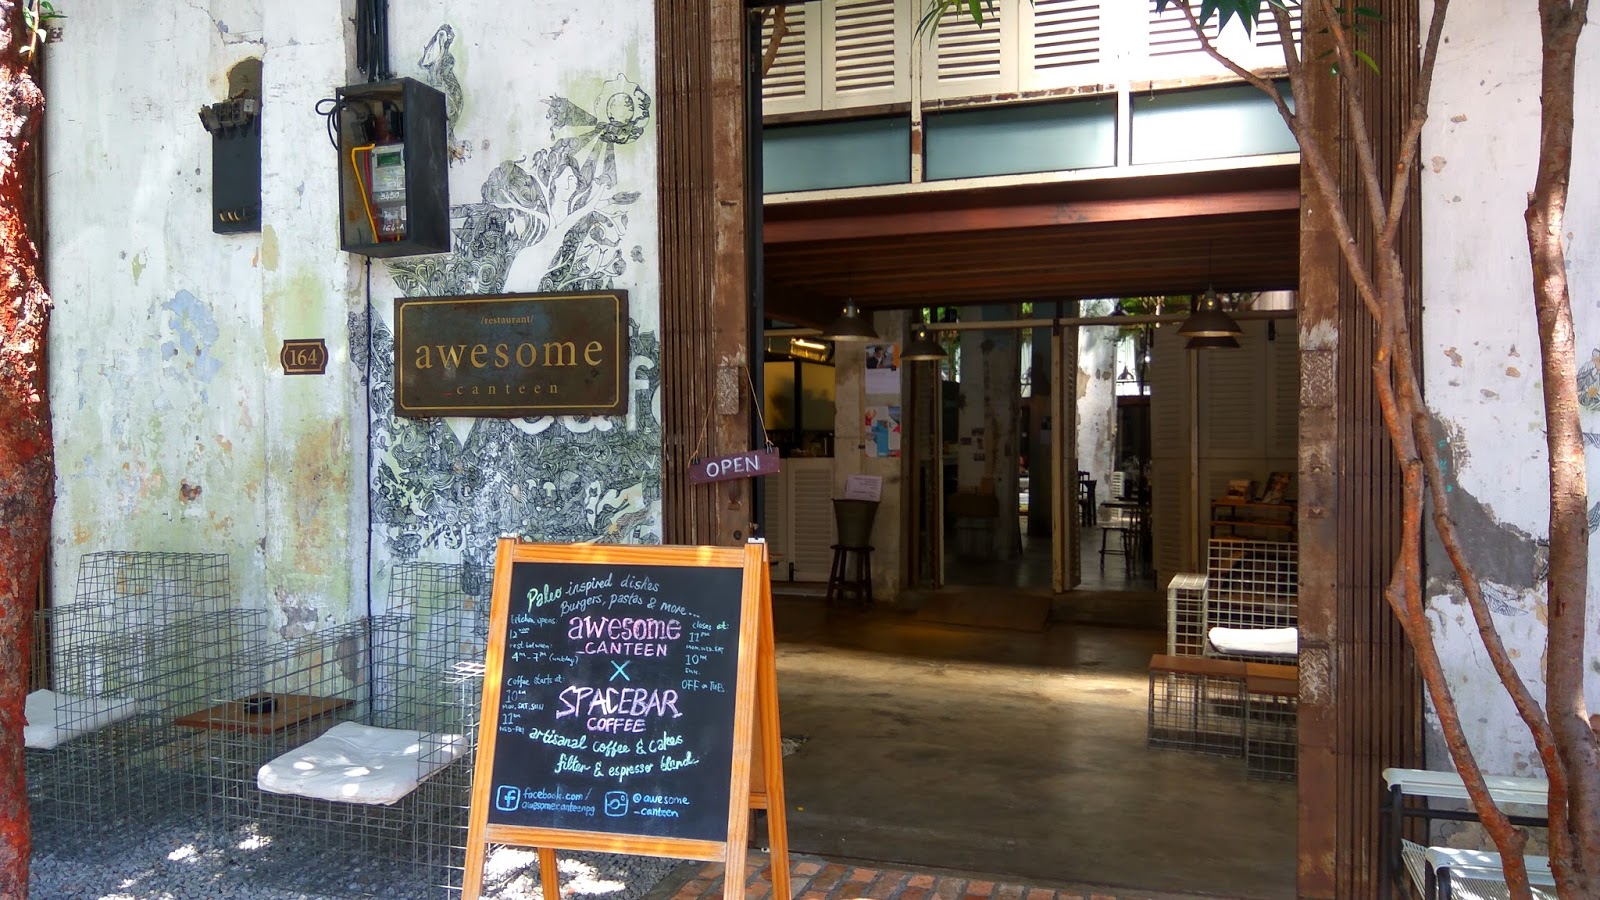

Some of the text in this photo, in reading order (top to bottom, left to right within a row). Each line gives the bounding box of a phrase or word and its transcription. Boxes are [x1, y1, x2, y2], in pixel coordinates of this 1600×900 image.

[290, 349, 317, 366] 164
[415, 340, 603, 369] awesome
[706, 455, 759, 477] OPEN
[527, 573, 659, 613] Paleo inspired dishes
[608, 592, 643, 610] pastas
[646, 597, 657, 609] &
[568, 615, 682, 641] awesome
[681, 679, 700, 691] OFF
[555, 684, 683, 719] SPACEBAR
[587, 717, 647, 734] COFFEE
[529, 727, 683, 757] artisanal coffee & cakes
[554, 753, 591, 774] filter
[594, 762, 604, 777] &
[608, 763, 654, 782] espresso
